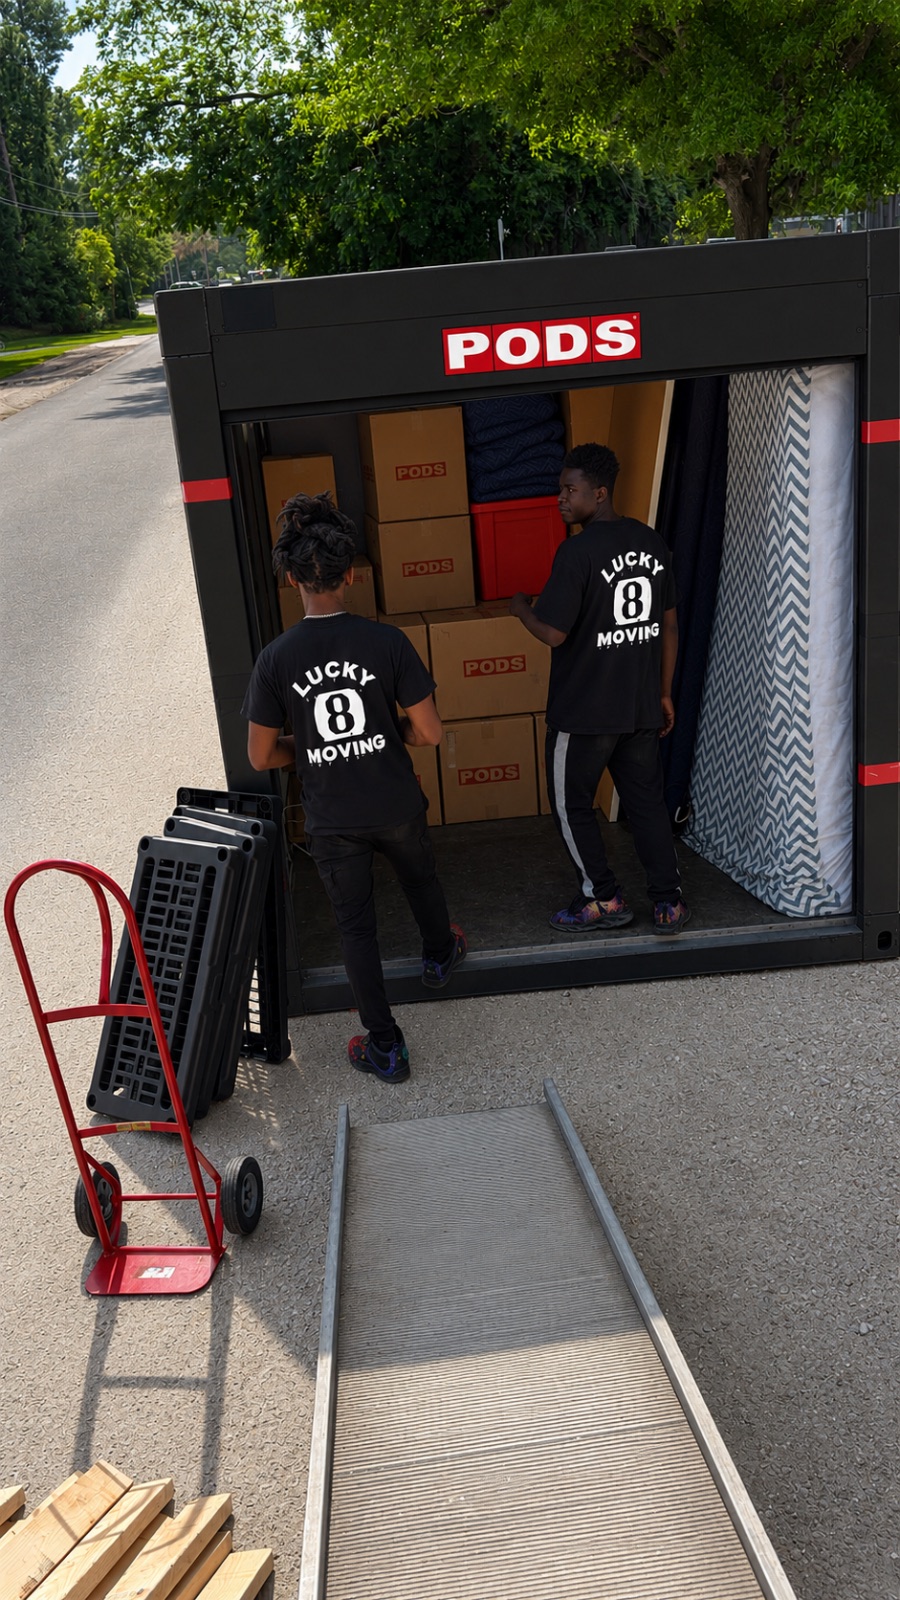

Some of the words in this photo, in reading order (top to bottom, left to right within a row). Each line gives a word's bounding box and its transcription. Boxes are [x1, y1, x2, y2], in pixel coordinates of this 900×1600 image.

[447, 319, 636, 370] PODS
[397, 463, 445, 480] PODS
[403, 559, 453, 576] PODS
[601, 551, 664, 584] LUCKY
[622, 581, 643, 619] 8
[597, 622, 660, 647] MOVING
[292, 661, 376, 698] LUCKY
[465, 656, 525, 676] PODS
[325, 693, 355, 735] 8
[307, 734, 386, 764] MOVING
[460, 765, 519, 784] PODS
